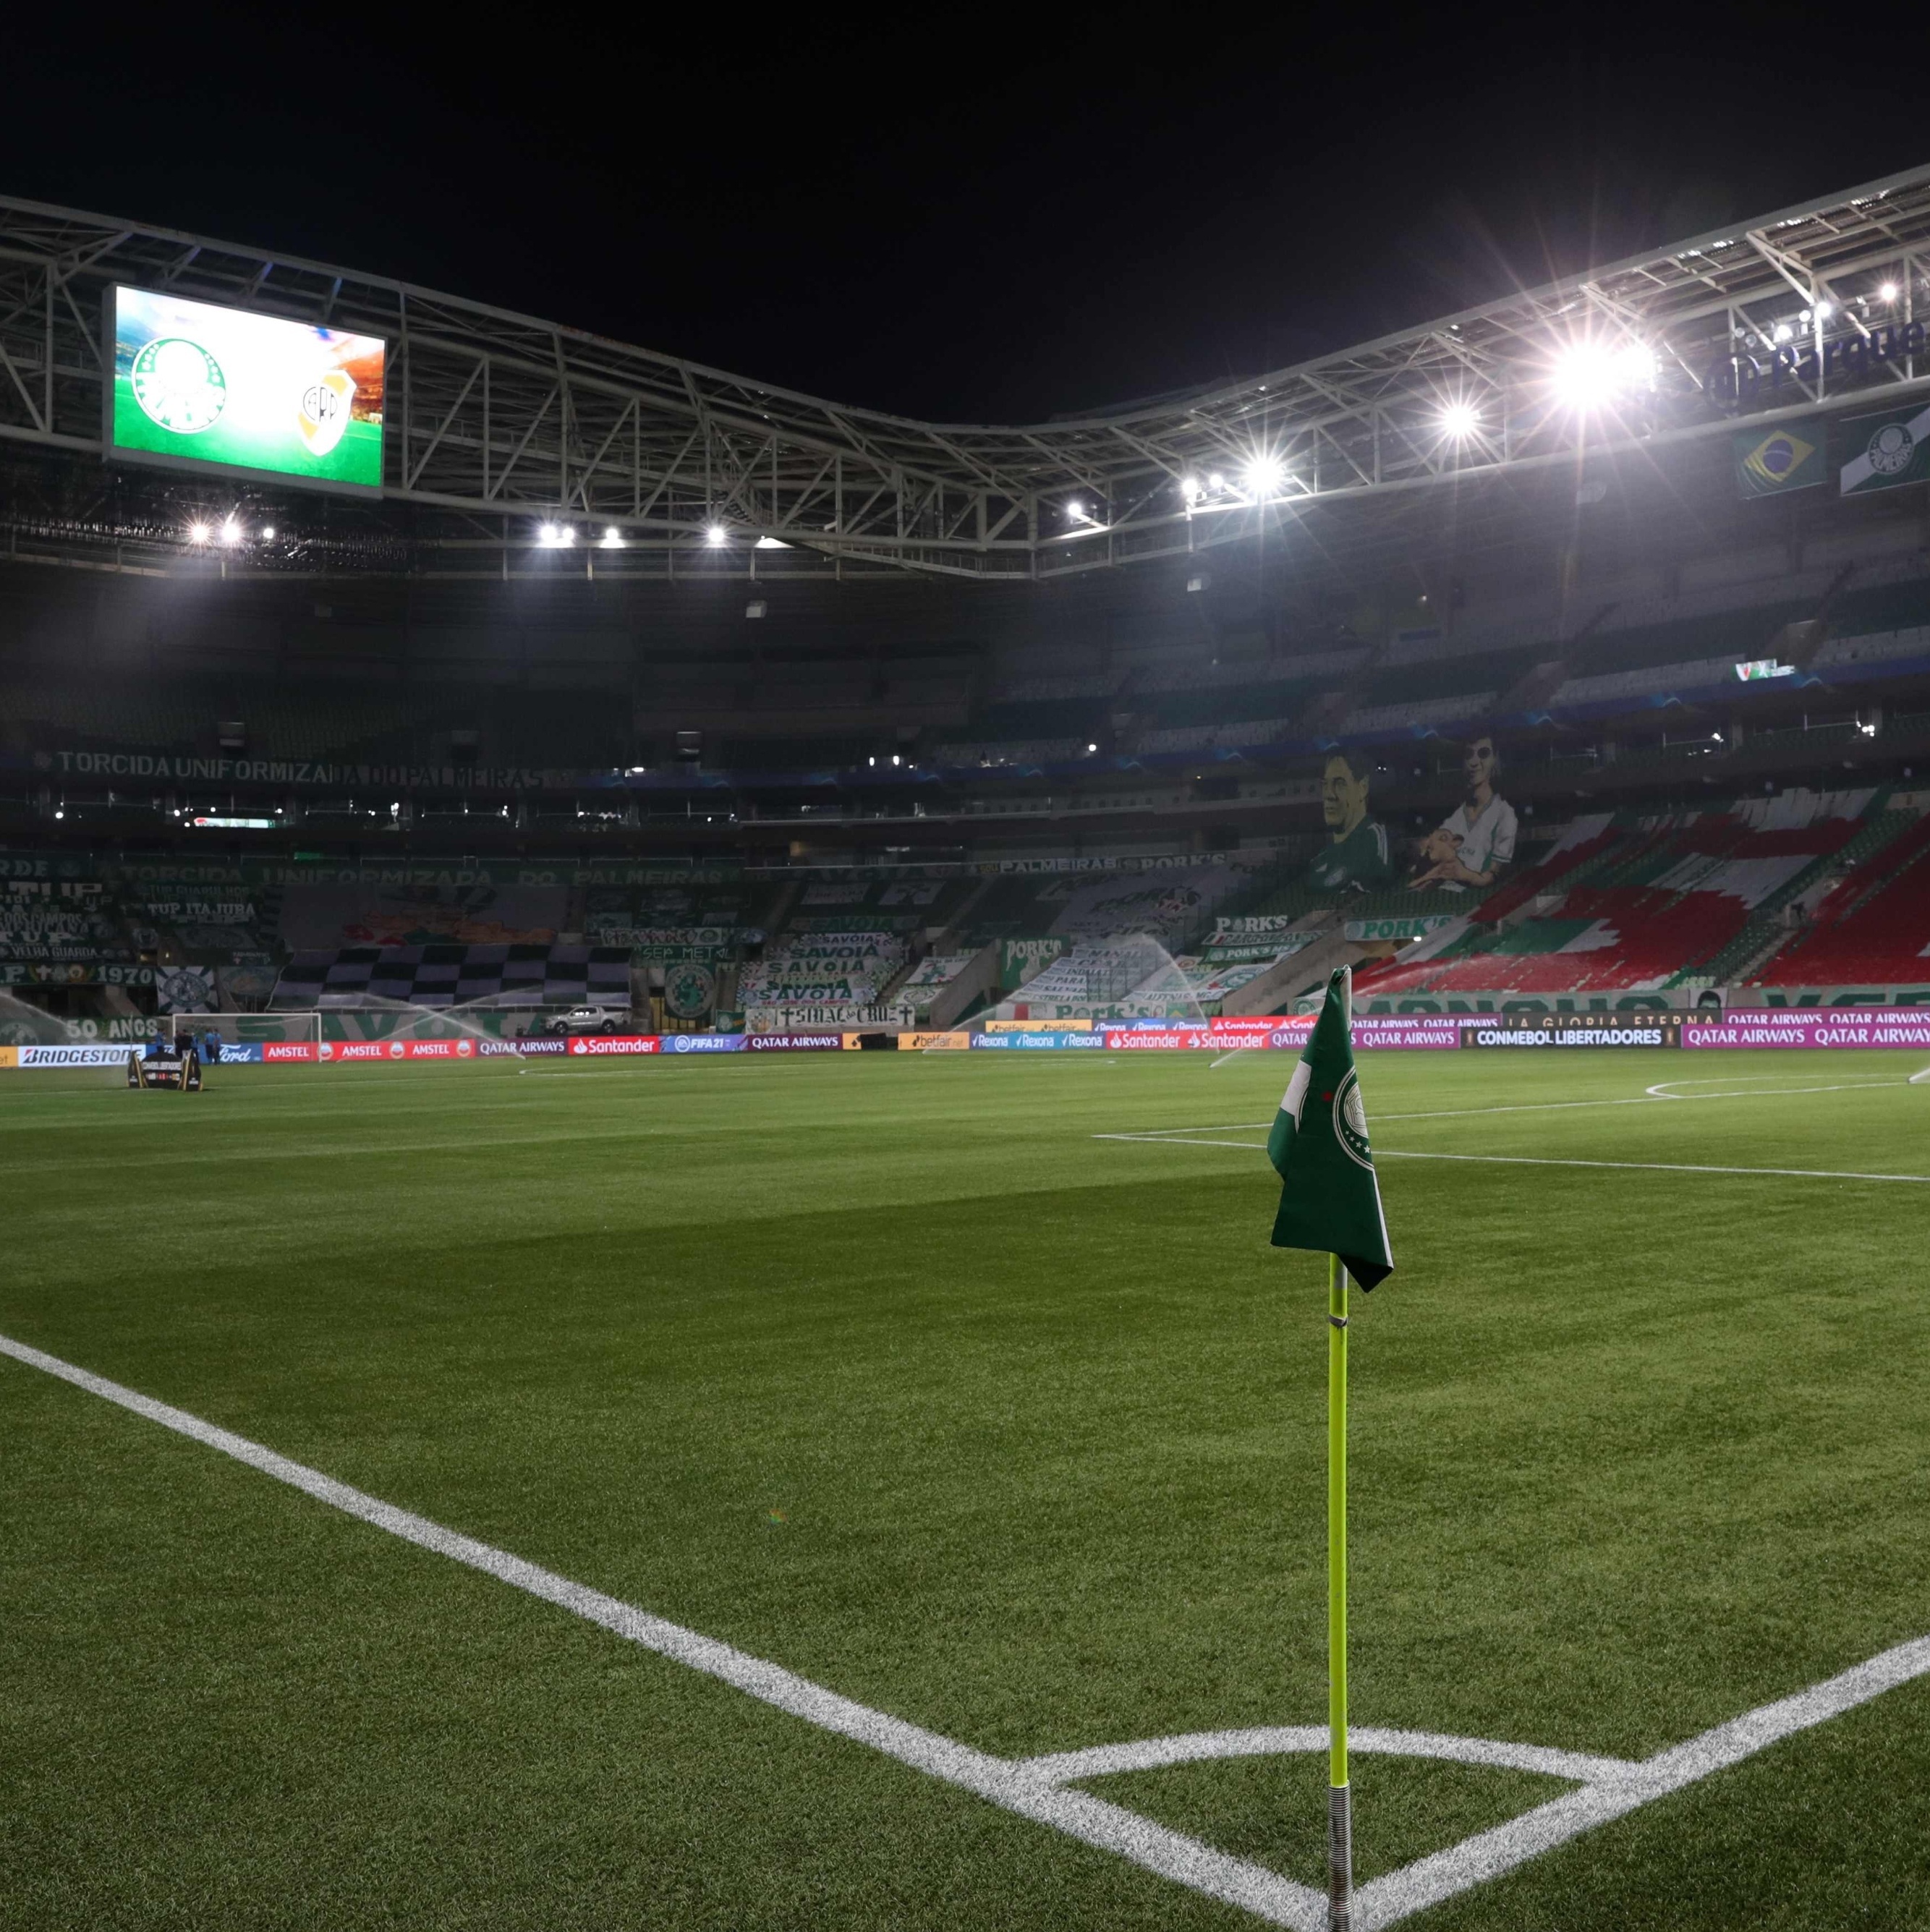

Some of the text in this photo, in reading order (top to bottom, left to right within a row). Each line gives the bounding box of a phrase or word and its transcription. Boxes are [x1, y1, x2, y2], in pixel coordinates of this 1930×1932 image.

[57, 751, 172, 777] TORCIDA
[1000, 858, 1116, 874] PALMEIRAS
[148, 903, 181, 915] TUP
[823, 935, 873, 943] SAVOIA
[11, 946, 49, 957] VELHA
[790, 945, 879, 958] SAVOIA
[1226, 946, 1270, 959] PORK'S
[768, 960, 864, 974] SAVOIA
[97, 966, 153, 984] 1970
[760, 989, 852, 1000] SAVOIA
[1771, 1014, 1822, 1024] AIRWAYS
[65, 1018, 158, 1039] 50 ANOS
[752, 1037, 838, 1049] QATAR AIRWAYS
[979, 1034, 1008, 1047] Rexona
[1023, 1034, 1055, 1047] Rexona
[1069, 1034, 1103, 1047] Rexona
[1123, 1032, 1180, 1048] Santander
[1202, 1031, 1264, 1048] Santander
[1272, 1032, 1308, 1047] QATAR
[1363, 1032, 1402, 1047] QATAR
[1404, 1031, 1454, 1044] AIRWAYS
[1477, 1029, 1662, 1045] CONMEBOL LIBERTADORES
[1688, 1029, 1805, 1045] QATAR AIRWAYS
[1815, 1028, 1868, 1046] QATAR
[268, 1046, 310, 1058] AMSTEL
[342, 1046, 382, 1057] AMSTEL
[412, 1044, 449, 1055] AMSTEL
[480, 1042, 565, 1055] QATAR AIRWAYS
[589, 1039, 655, 1052] Santander
[22, 1049, 143, 1065] BRIDGESTONE
[218, 1044, 252, 1063] Ford
